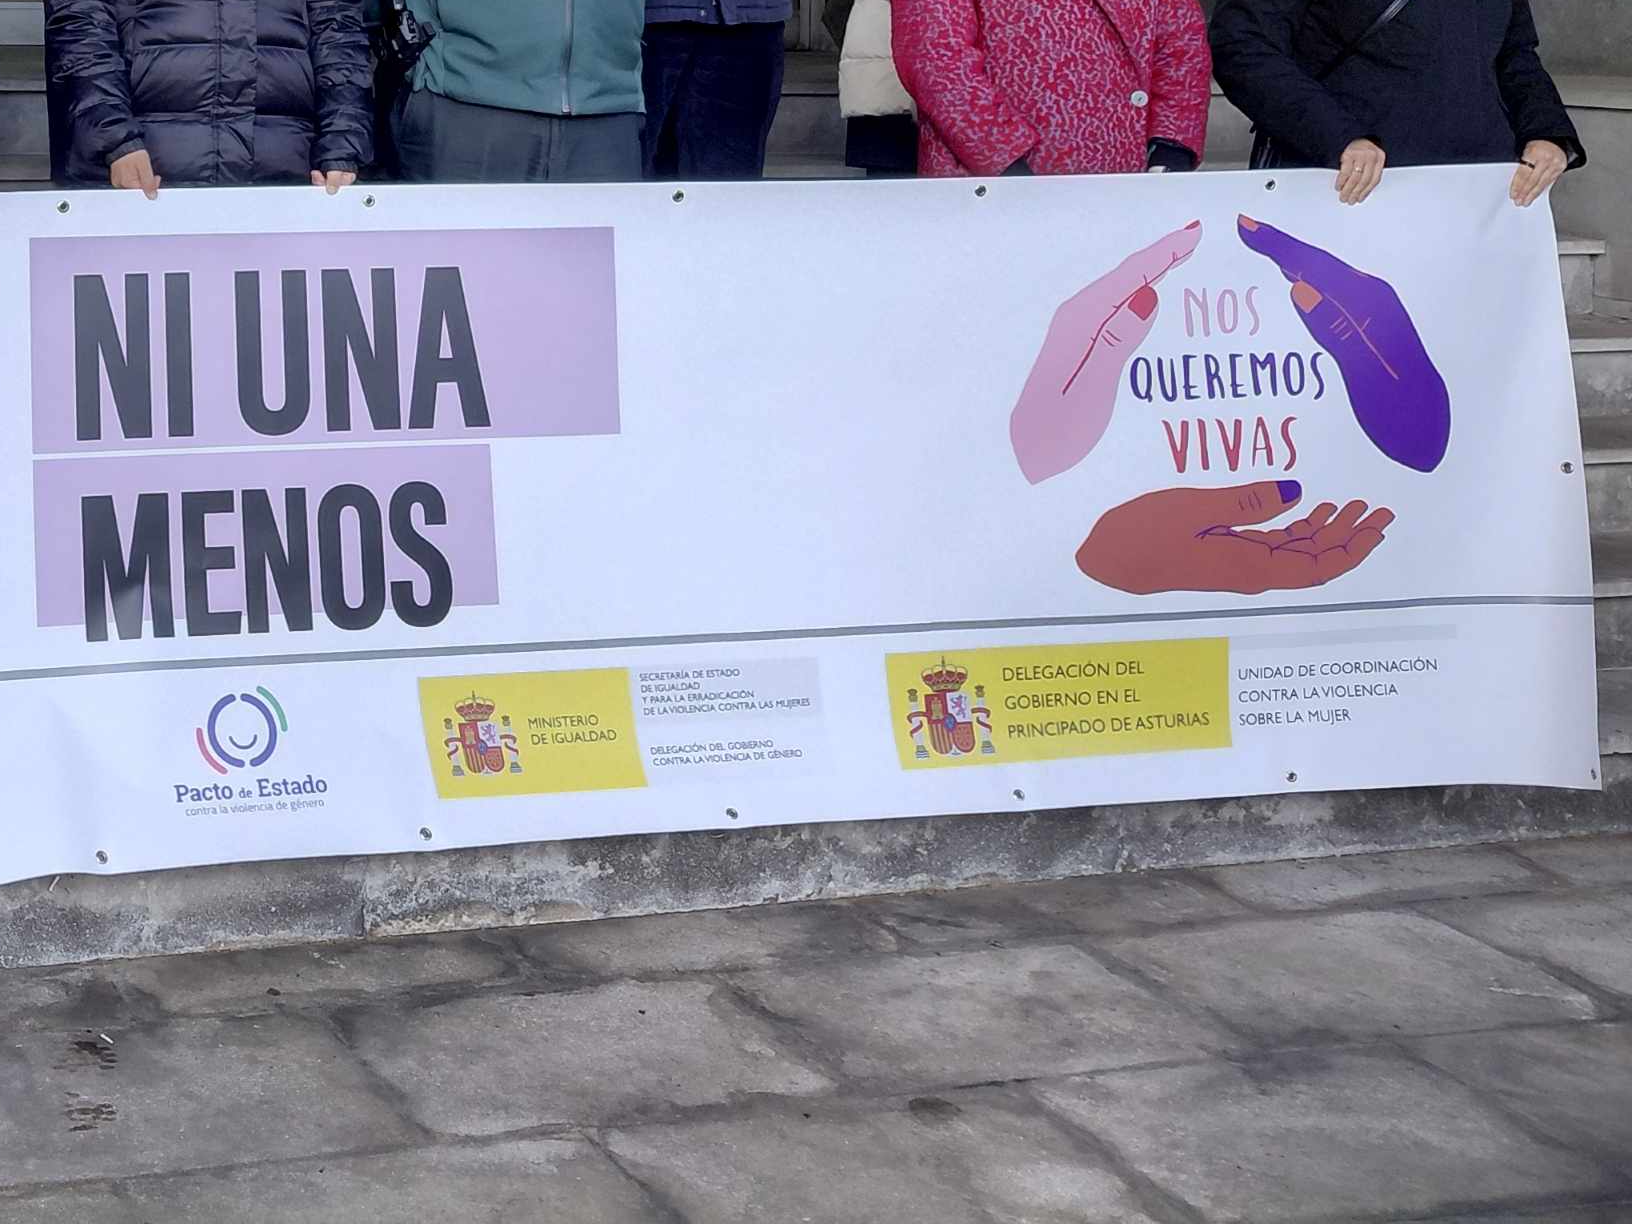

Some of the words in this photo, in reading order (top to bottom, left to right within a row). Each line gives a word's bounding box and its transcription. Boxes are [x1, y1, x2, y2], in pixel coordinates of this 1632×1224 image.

[1183, 286, 1260, 338] NOS
[72, 272, 194, 441] NI
[234, 266, 491, 437] UNA
[1129, 351, 1324, 403] QUEREMOS
[1161, 416, 1298, 474] VIVAS
[81, 480, 454, 643] MENOS
[639, 670, 690, 681] SECRETARÍA
[692, 670, 704, 679] DE
[706, 668, 740, 678] ESTADO
[1002, 660, 1110, 681] DELEGACIÓN
[1115, 661, 1145, 676] DEL
[1238, 665, 1294, 680] UNIDAD
[1298, 664, 1316, 677] DE
[1319, 656, 1438, 676] COORDINACIÓN
[641, 684, 653, 693] DE
[654, 681, 700, 692] IGUALDAD
[1238, 688, 1299, 703] CONTRA
[1303, 687, 1320, 699] LA
[1320, 683, 1399, 698] VIOLENCIA
[642, 696, 648, 705] Y
[650, 695, 672, 704] PARA
[674, 694, 685, 703] LA
[643, 707, 655, 716] DE
[657, 706, 668, 715] LA
[668, 703, 716, 714] VIOLENCIA
[718, 701, 757, 712] CONTRA
[759, 700, 774, 710] LAS
[775, 697, 811, 709] MUJERES
[1004, 691, 1092, 710] GOBIERNO
[1097, 690, 1118, 704] EN
[1124, 688, 1141, 703] EL
[527, 714, 599, 729] MINISTERIO
[1007, 718, 1106, 739] PRINCIPADO
[1111, 717, 1132, 732] DE
[1135, 711, 1210, 730] ASTURIAS
[1239, 711, 1283, 726] SOBRE
[1286, 710, 1304, 724] LA
[1308, 708, 1352, 726] MUJER
[531, 733, 548, 745] DE
[552, 729, 617, 744] IGUALDAD
[650, 742, 707, 755] DELEGACIÓN
[709, 742, 725, 752] DEL
[727, 739, 774, 750] GOBIERNO
[652, 756, 692, 767] CONTRA
[693, 755, 704, 764] LA
[704, 752, 752, 764] VIOLENCIA
[754, 751, 766, 760] DE
[174, 783, 233, 802] Pacto
[238, 787, 253, 798] de
[256, 774, 328, 797] Estado
[185, 804, 218, 816] contra
[219, 804, 229, 814] la
[230, 800, 274, 814] violencia
[275, 800, 288, 810] de
